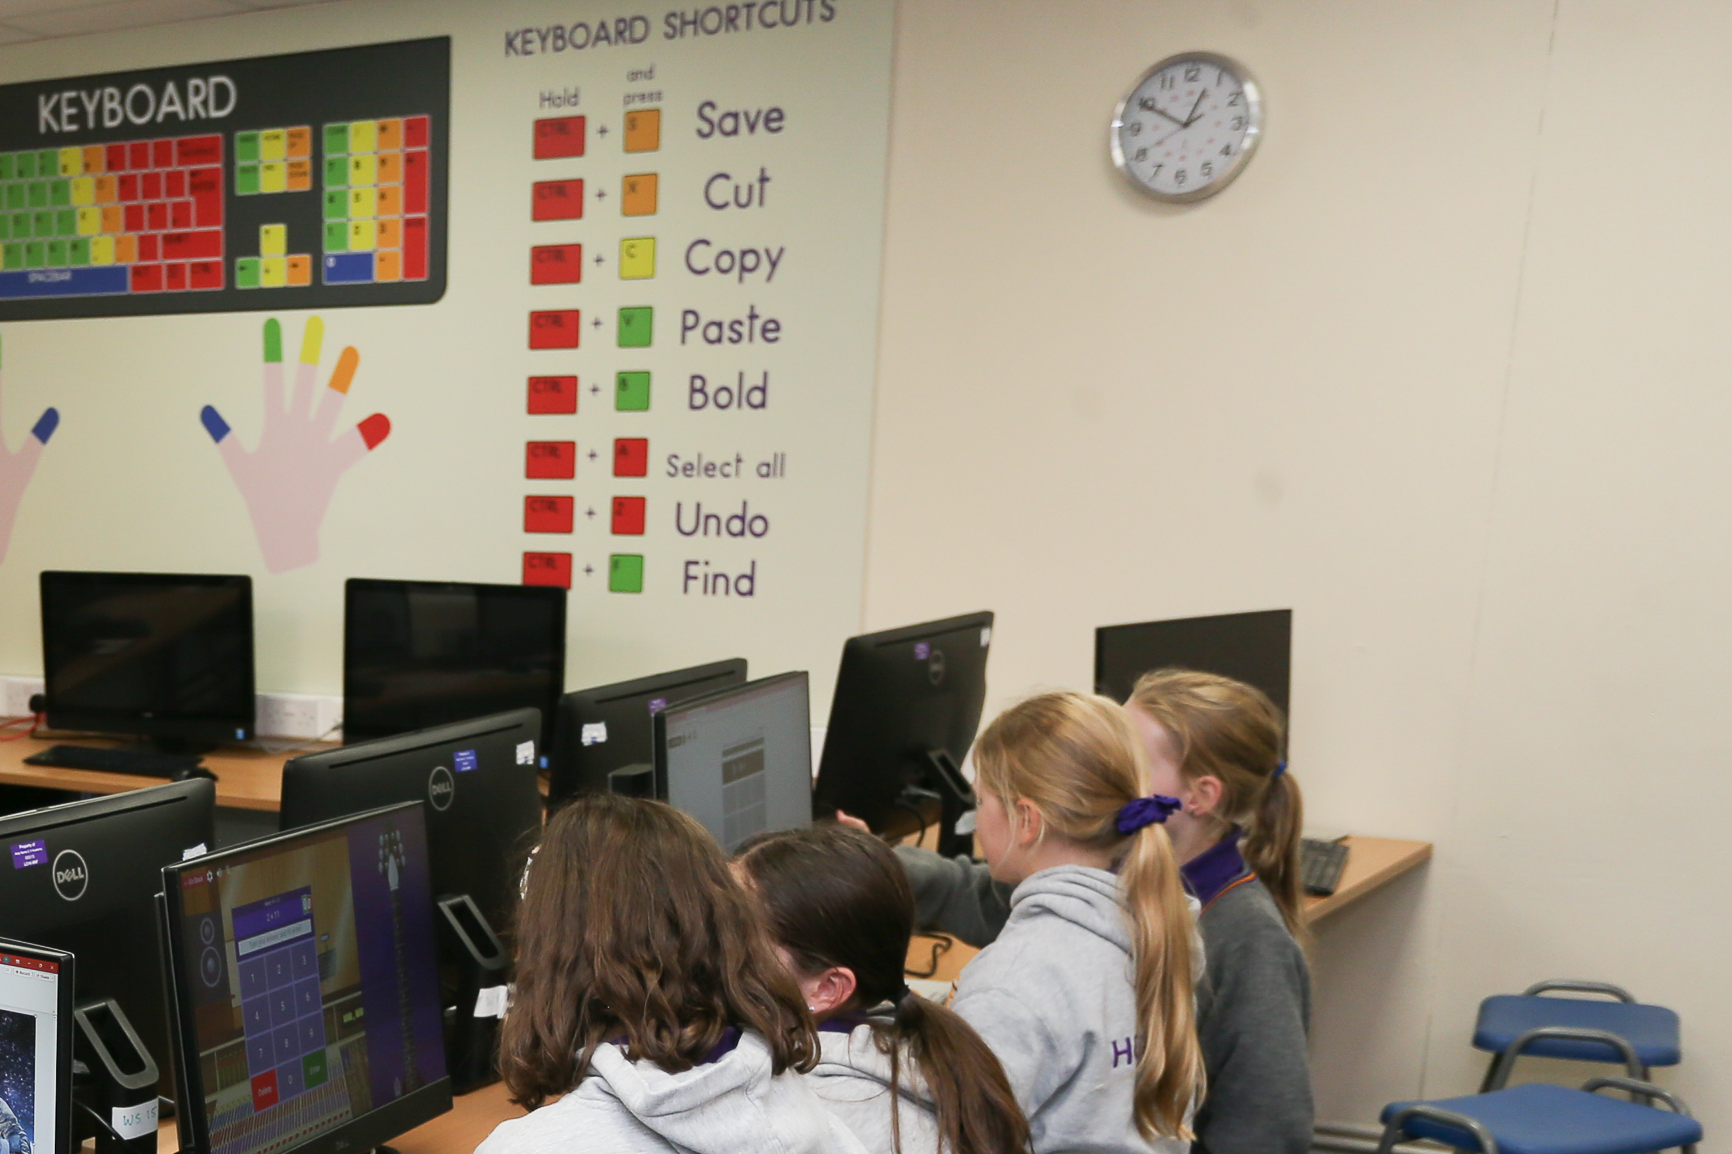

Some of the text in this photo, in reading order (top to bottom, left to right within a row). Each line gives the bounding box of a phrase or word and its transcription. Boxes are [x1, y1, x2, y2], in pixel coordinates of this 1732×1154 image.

[504, 0, 838, 57] KEYBOARD SHORTCUTS
[626, 64, 656, 82] and
[1160, 74, 1174, 90] 11
[1184, 67, 1200, 82] 12
[1216, 69, 1223, 87] 1
[38, 75, 238, 134] KEYBOARD
[539, 88, 580, 109] Hold
[622, 89, 663, 107] press
[1227, 91, 1242, 107] 2
[539, 121, 570, 138] CTRL
[696, 100, 785, 139] Save
[1231, 116, 1243, 131] 3
[1130, 122, 1143, 137] 9
[1135, 147, 1148, 163] 8
[1220, 143, 1235, 157] 4
[1150, 163, 1164, 179] 7
[1174, 169, 1187, 185] 6
[1201, 161, 1213, 178] 5
[538, 184, 568, 200] CTRL
[703, 166, 772, 210] Cut
[535, 249, 567, 264] CTRL
[685, 239, 785, 284] Copy
[534, 314, 564, 328] CTRL
[680, 304, 782, 346] Paste
[532, 379, 563, 394] CTRL
[688, 370, 769, 411] Bold
[530, 445, 561, 459] CTRL
[666, 451, 743, 479] Select
[756, 451, 786, 479] all
[530, 499, 560, 513] CTRL
[675, 499, 770, 538] Undo
[527, 555, 557, 570] CTRL
[683, 560, 756, 597] Find
[431, 781, 452, 796] DELL
[56, 867, 85, 884] DELL
[258, 1086, 272, 1097] Delete
